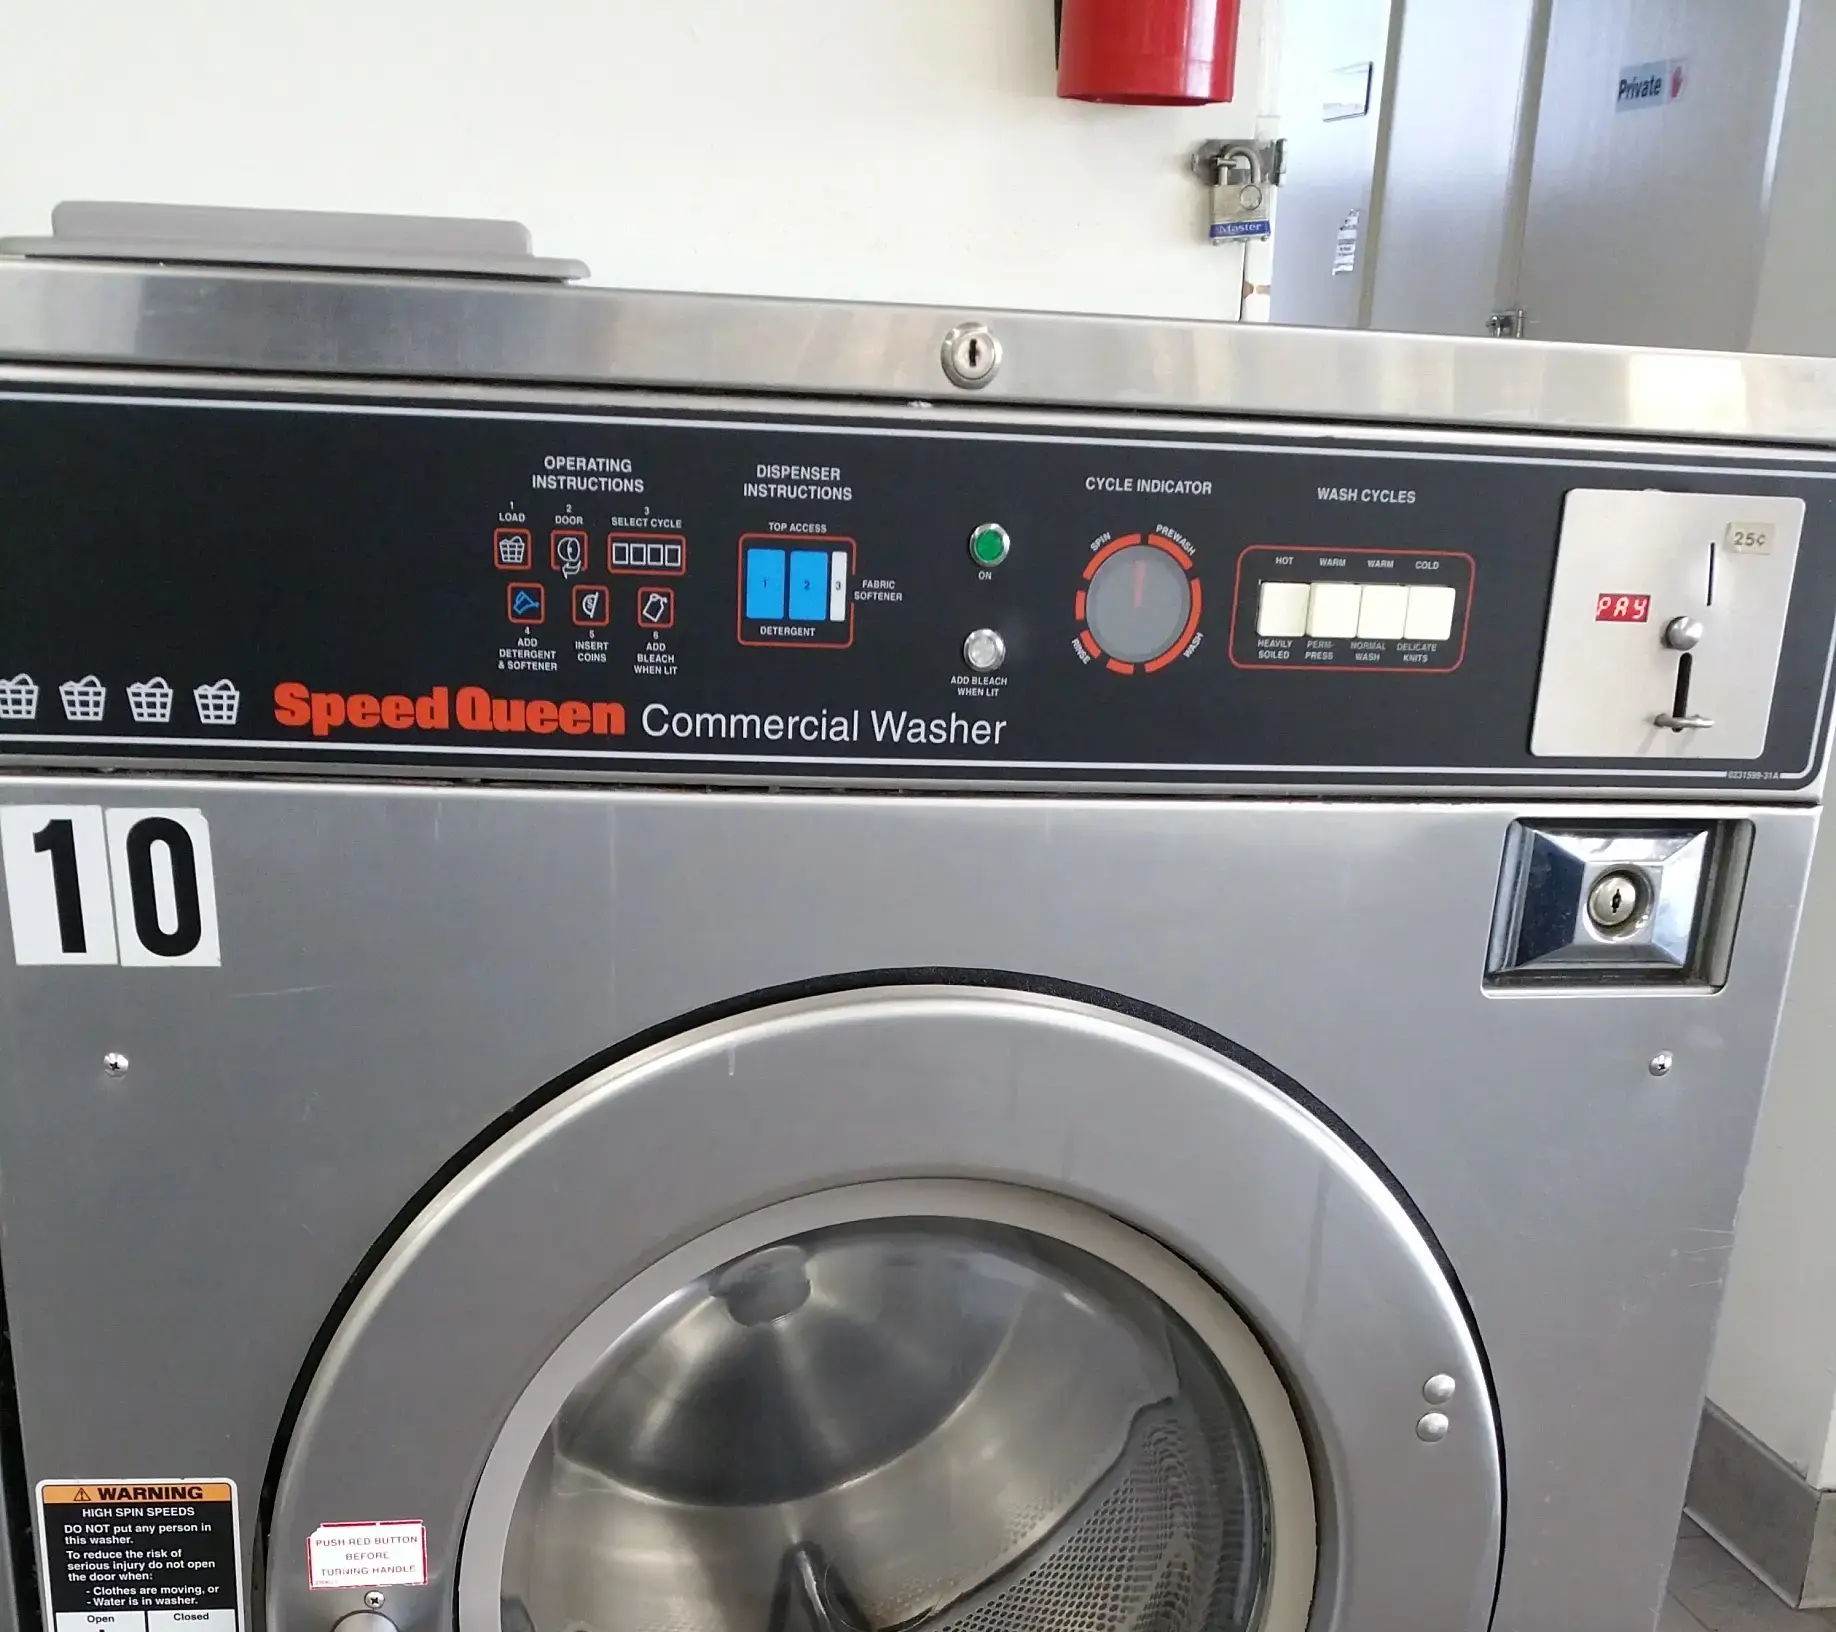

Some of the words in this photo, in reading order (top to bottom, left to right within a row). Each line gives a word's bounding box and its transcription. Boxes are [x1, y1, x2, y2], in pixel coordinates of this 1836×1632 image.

[1618, 74, 1662, 102] Private
[1219, 224, 1261, 233] Master
[544, 455, 632, 473] OPERATING
[757, 465, 840, 481] DISPENSER
[532, 474, 644, 493] INSTRUCTIONS
[1086, 477, 1133, 492] CYCLE
[1136, 479, 1212, 495] INDICATOR
[743, 483, 852, 500] INSTRUCTIONS
[1317, 487, 1358, 501] WASH
[1361, 489, 1416, 503] CYCLES
[510, 501, 514, 510] 1
[566, 504, 571, 513] 2
[644, 506, 650, 516] 3
[499, 513, 525, 522] LOAD
[555, 516, 583, 525] DOOR
[611, 517, 648, 527] SELECT
[651, 518, 682, 528] CYCLE
[769, 522, 787, 532] TOP
[790, 523, 827, 533] ACCESS
[1090, 531, 1111, 552] SPIN
[1155, 523, 1197, 556] PREWASH
[1734, 532, 1766, 547] 25¢
[1276, 557, 1294, 565] HOT
[1319, 558, 1346, 566] WARM
[1368, 559, 1394, 568] WARM
[1415, 561, 1439, 570] COLD
[978, 571, 992, 581] ON
[763, 580, 767, 588] 1
[804, 581, 810, 590] 2
[835, 582, 841, 590] 3
[862, 580, 895, 589] FABRIC
[854, 591, 902, 601] SOFTENER
[1598, 596, 1647, 619] PAY
[524, 626, 531, 635] 4
[589, 630, 595, 638] 5
[653, 631, 658, 639] 6
[760, 626, 816, 636] DETERGENT
[517, 638, 538, 647] ADD
[575, 641, 609, 650] INSERT
[646, 643, 666, 651] ADD
[1183, 632, 1204, 658] WASH
[1257, 640, 1293, 649] HEAVILY
[1351, 641, 1386, 650] NORMAL
[1397, 643, 1437, 652] DELICATE
[499, 649, 556, 659] DETERGENT
[1071, 638, 1091, 665] RINSE
[1258, 650, 1290, 660] SOILED
[1305, 651, 1334, 660] PRESS
[578, 653, 607, 662] COINS
[637, 654, 675, 663] BLEACH
[1355, 653, 1380, 661] WASH
[1403, 654, 1428, 663] KNITS
[499, 660, 504, 669] &
[508, 661, 557, 671] SOFTENER
[634, 665, 662, 674] WHEN
[664, 666, 678, 675] LIT
[950, 676, 969, 685] ADD
[972, 676, 1007, 686] BLEACH
[957, 687, 983, 696] WHEN
[986, 688, 1000, 697] LIT
[274, 681, 450, 736] Speed
[456, 686, 626, 736] Queen
[642, 703, 859, 742] Commercial
[871, 709, 1008, 745] Washer
[32, 816, 202, 958] 10
[97, 1486, 203, 1500] WARNING
[82, 1509, 112, 1517] HIGH
[116, 1508, 144, 1517] SPIN
[147, 1507, 195, 1516] SPEEDS
[64, 1525, 82, 1534] DO
[85, 1524, 110, 1533] NOT
[114, 1524, 132, 1534] put
[135, 1525, 155, 1534] any
[159, 1524, 198, 1534] person
[201, 1523, 212, 1532] in
[65, 1536, 87, 1545] this
[89, 1535, 133, 1544] washer.
[375, 1536, 418, 1544] BUTTON
[66, 1551, 81, 1559] To
[84, 1550, 122, 1559] reduce
[125, 1550, 142, 1558] the
[147, 1549, 168, 1558] risk
[170, 1549, 182, 1558] of
[346, 1552, 390, 1560] BEFORE
[67, 1561, 110, 1571] serious
[113, 1561, 145, 1572] injury
[149, 1561, 163, 1569] do
[166, 1561, 184, 1569] not
[187, 1560, 215, 1571] open
[321, 1567, 368, 1576] TURNING
[373, 1565, 415, 1574] HANDLE
[68, 1573, 86, 1581] the
[89, 1572, 116, 1581] door
[119, 1571, 153, 1580] when:
[93, 1587, 136, 1595] Clothes
[161, 1586, 205, 1595] moving,
[94, 1598, 126, 1606] Water
[128, 1597, 139, 1606] is
[142, 1597, 152, 1605] in
[156, 1597, 198, 1605] washer.
[87, 1615, 115, 1624] Open
[173, 1613, 209, 1621] Closed
